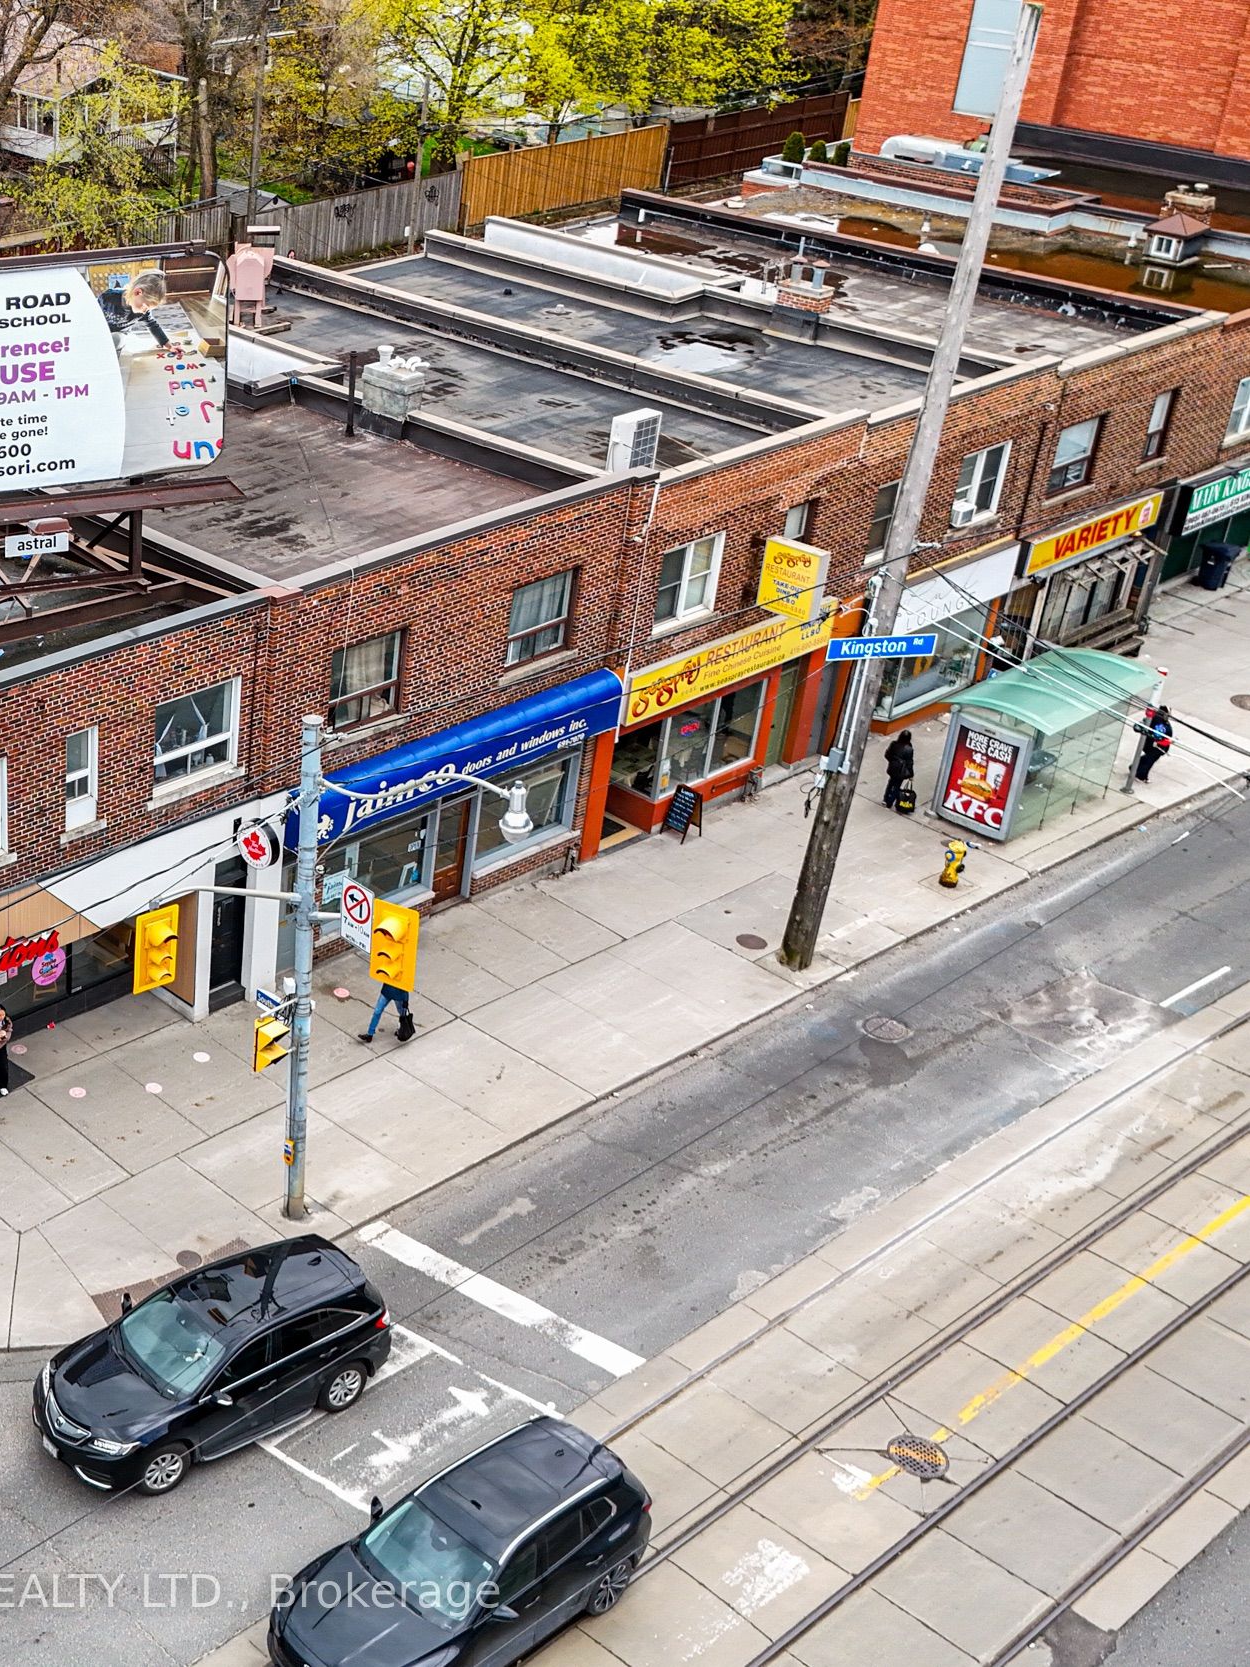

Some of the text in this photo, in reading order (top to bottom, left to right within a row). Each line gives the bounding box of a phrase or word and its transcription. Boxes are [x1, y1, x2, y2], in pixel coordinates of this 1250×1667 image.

[6, 292, 71, 311] ROAD
[55, 384, 89, 399] 1PM
[18, 413, 48, 426] time
[11, 426, 48, 441] gone!
[17, 535, 57, 551] astral
[1054, 507, 1138, 560] VARIETY
[766, 563, 811, 584] RESTAURANT
[705, 622, 787, 667] RESTAURANT
[841, 639, 907, 657] Kingston
[913, 637, 924, 646] Rd
[703, 668, 721, 680] Fine
[722, 658, 750, 673] Chinese
[753, 644, 782, 660] Cuisine
[462, 755, 492, 775] doors
[496, 742, 517, 761] and
[520, 725, 566, 752] windows
[569, 719, 587, 732] inc.
[966, 738, 986, 754] LESS
[988, 747, 1012, 763] CASH
[967, 730, 988, 745] MORE
[989, 739, 1014, 755] CRAVE
[943, 789, 1004, 828] KFC
